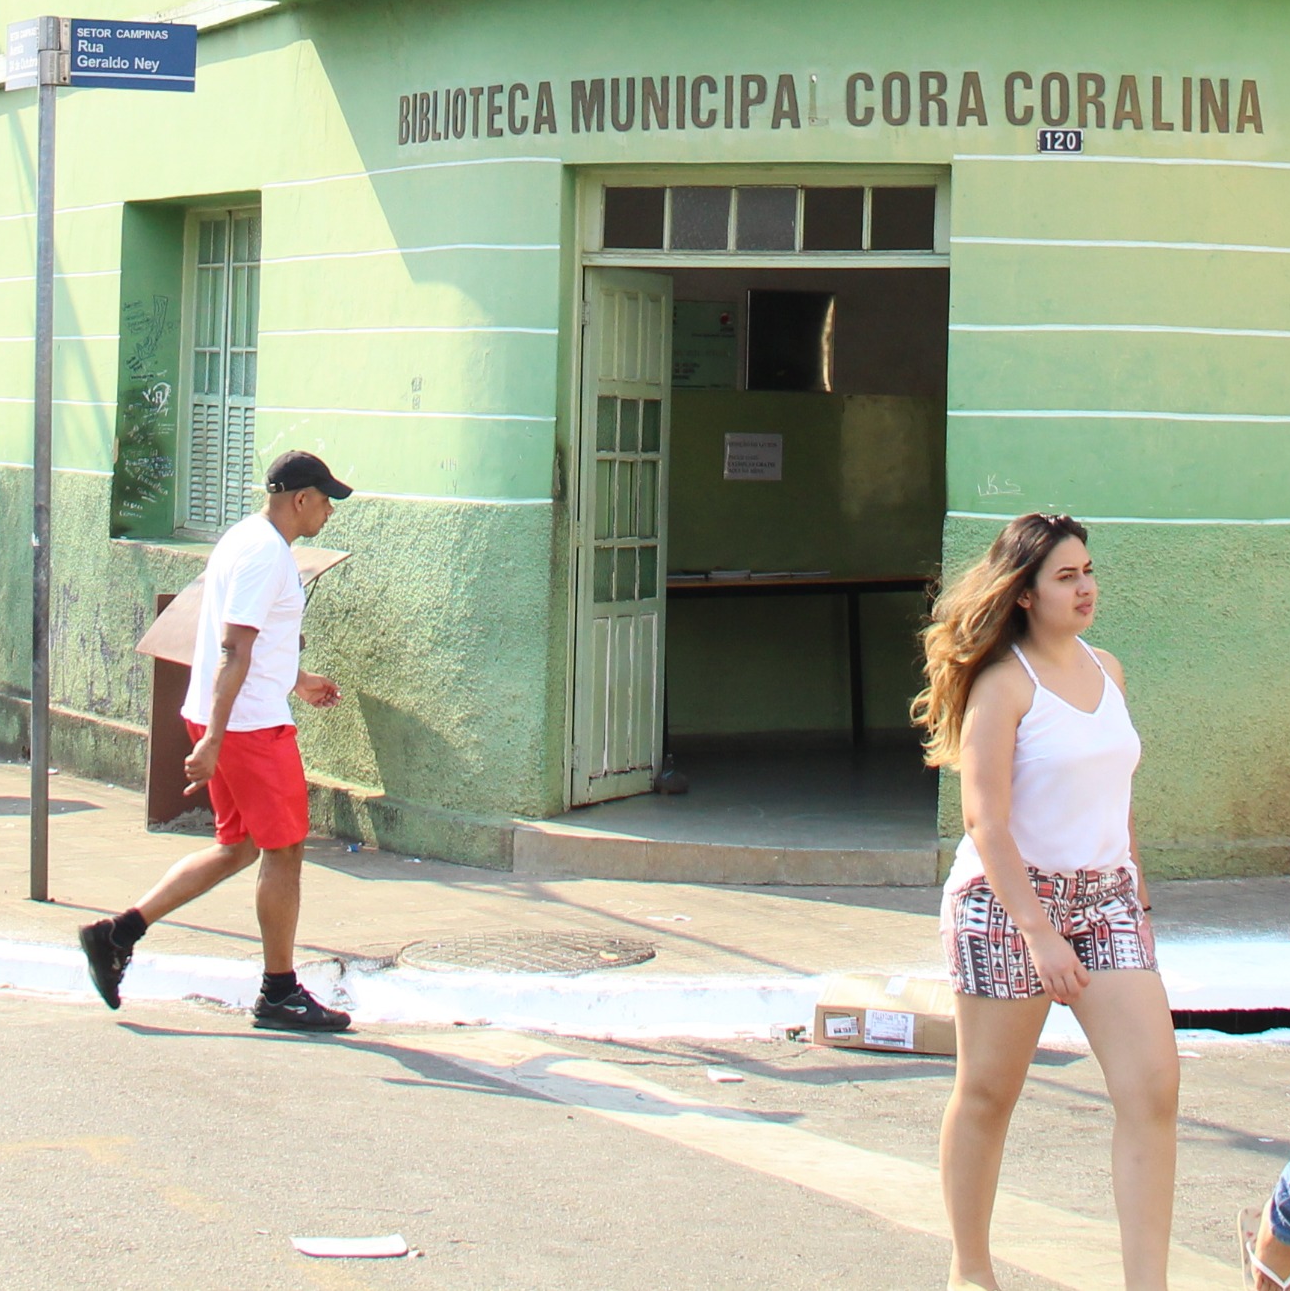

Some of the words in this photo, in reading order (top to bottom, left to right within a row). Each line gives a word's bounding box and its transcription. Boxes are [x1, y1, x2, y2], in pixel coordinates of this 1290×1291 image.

[77, 27, 112, 39] SETOR
[116, 29, 169, 41] CAMPINAS
[77, 40, 104, 53] Rua
[77, 55, 130, 70] Geraldo
[134, 57, 160, 73] Ney
[398, 80, 558, 146] BIBLIOTECA
[846, 71, 988, 128] CORA
[1004, 71, 1265, 135] CORALINA
[1044, 132, 1077, 151] 120
